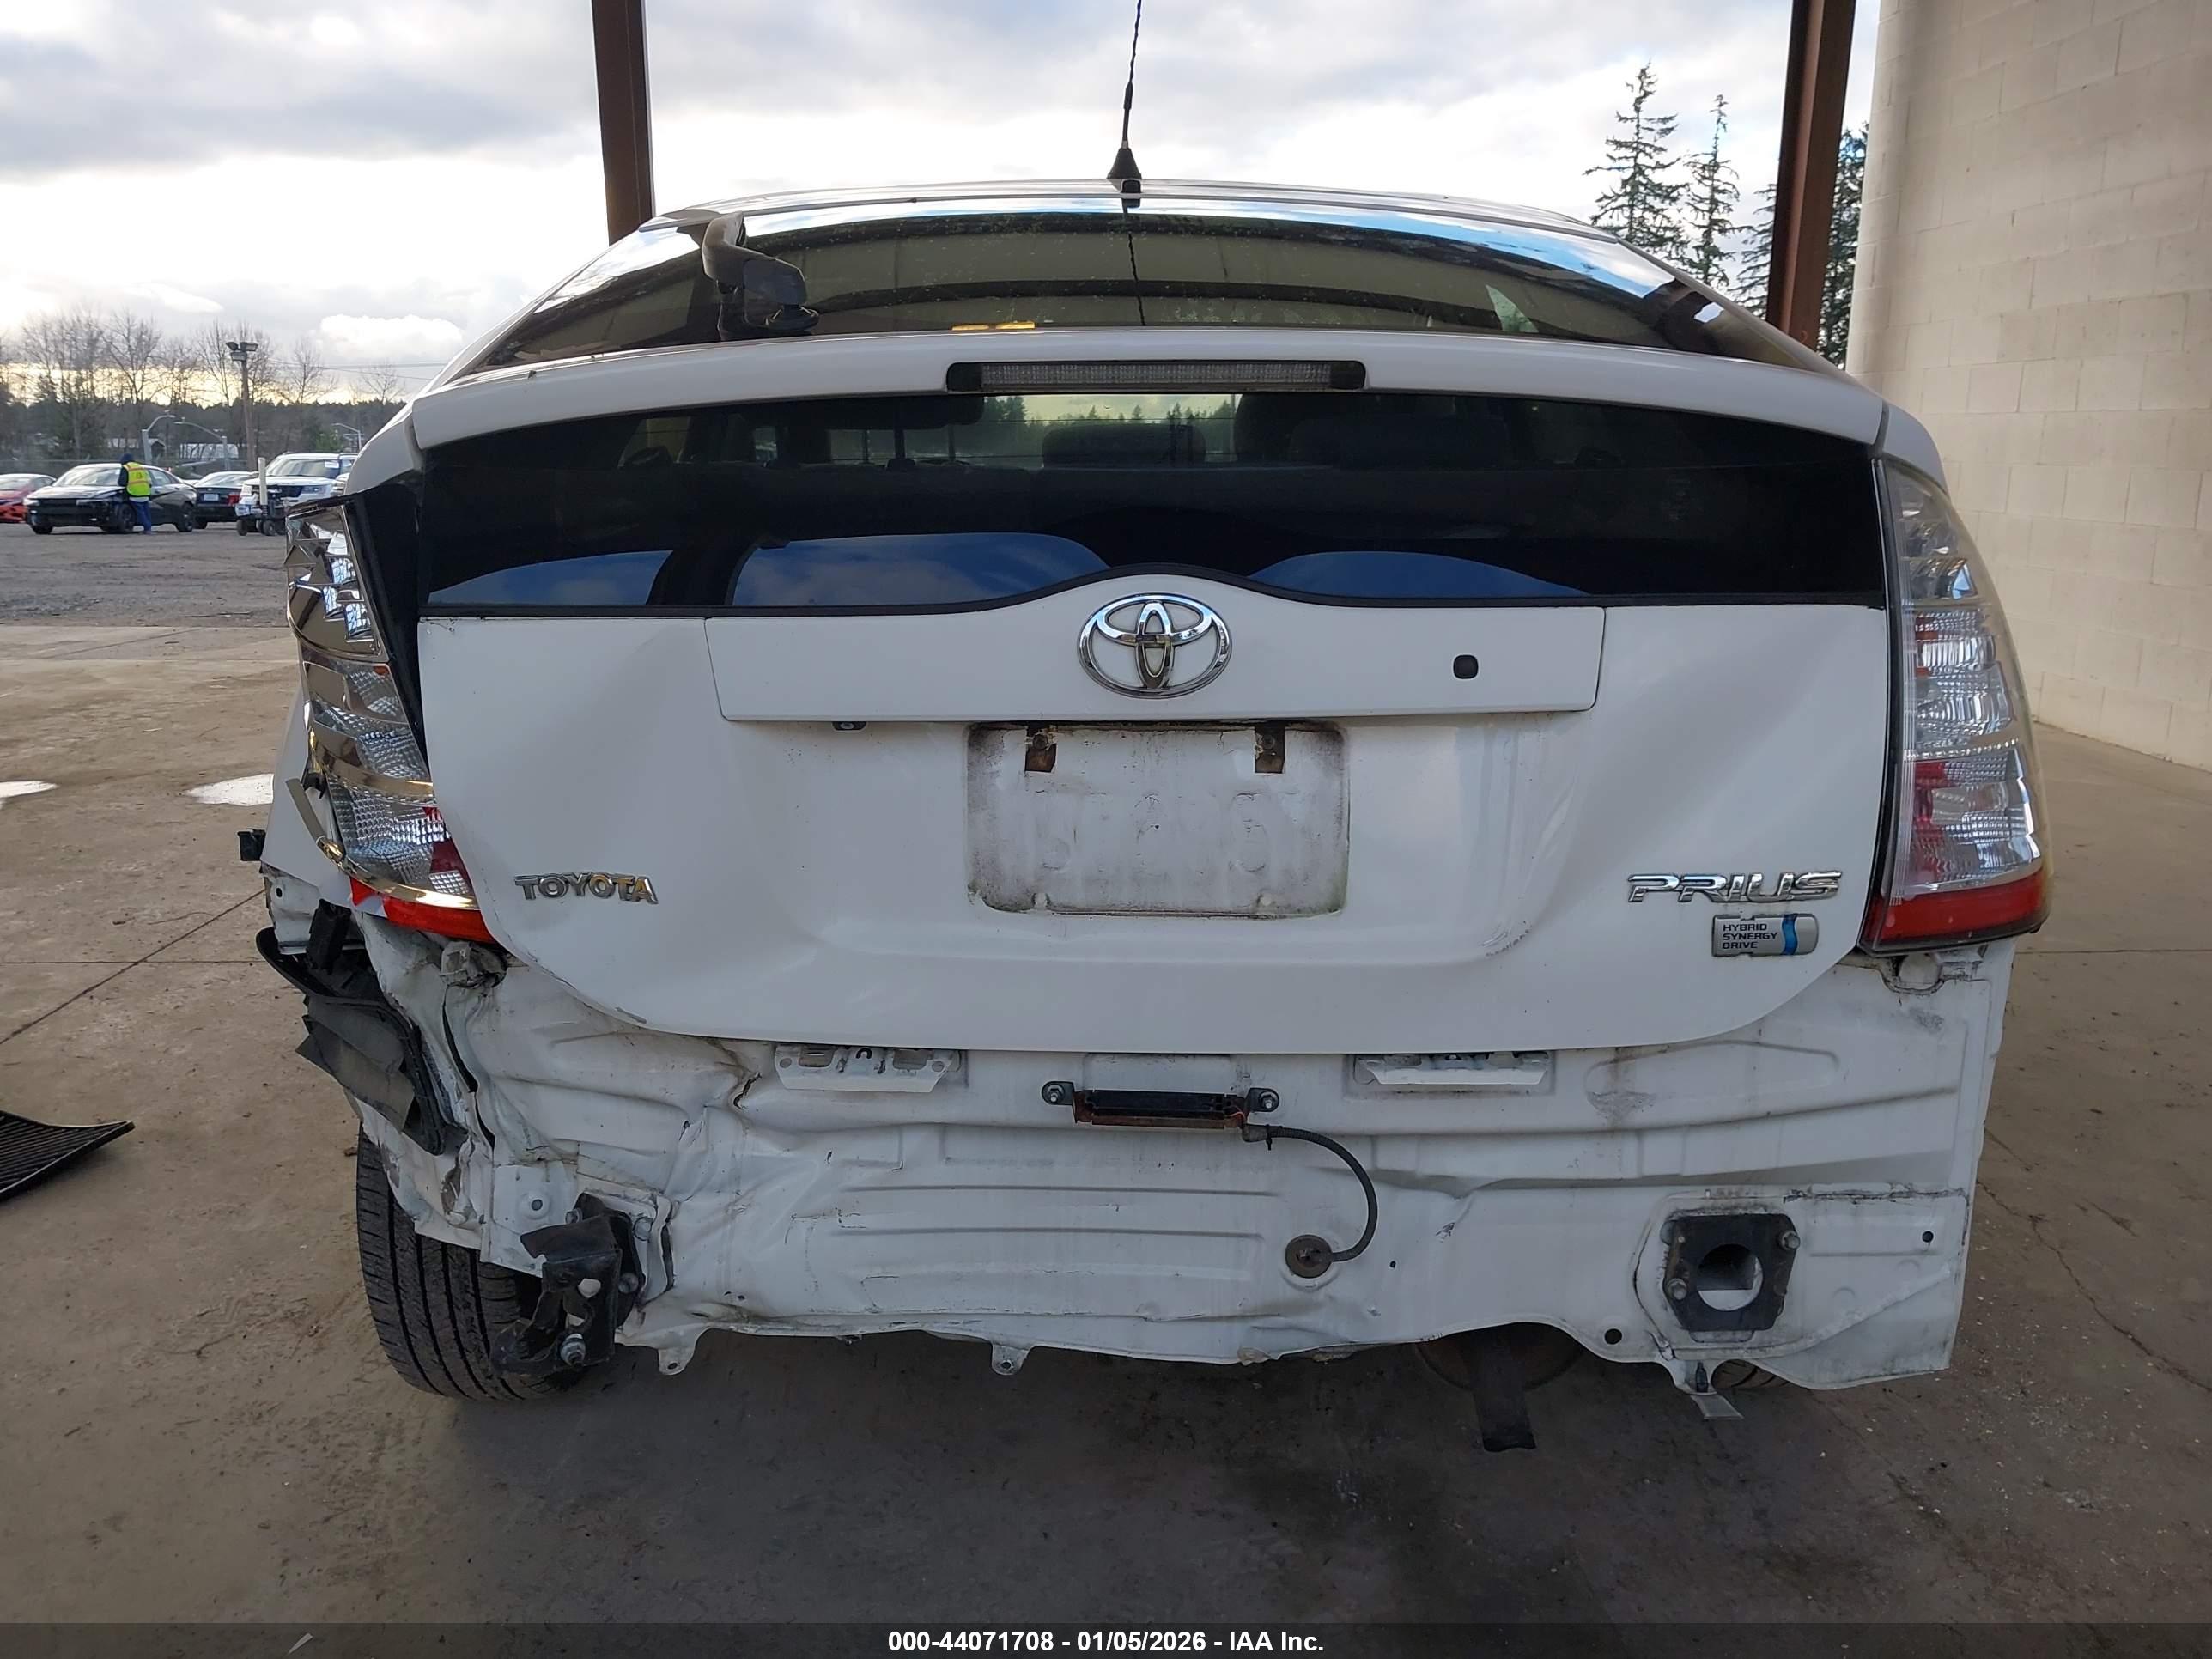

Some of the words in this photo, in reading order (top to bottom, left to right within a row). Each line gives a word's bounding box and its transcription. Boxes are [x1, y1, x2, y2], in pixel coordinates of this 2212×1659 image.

[514, 872, 659, 904] TOYOTA
[1627, 870, 1842, 902] PRIUS
[1723, 923, 1767, 932] HYBRID
[1723, 932, 1778, 941] SYNERGY
[1722, 941, 1758, 950] DRIVE
